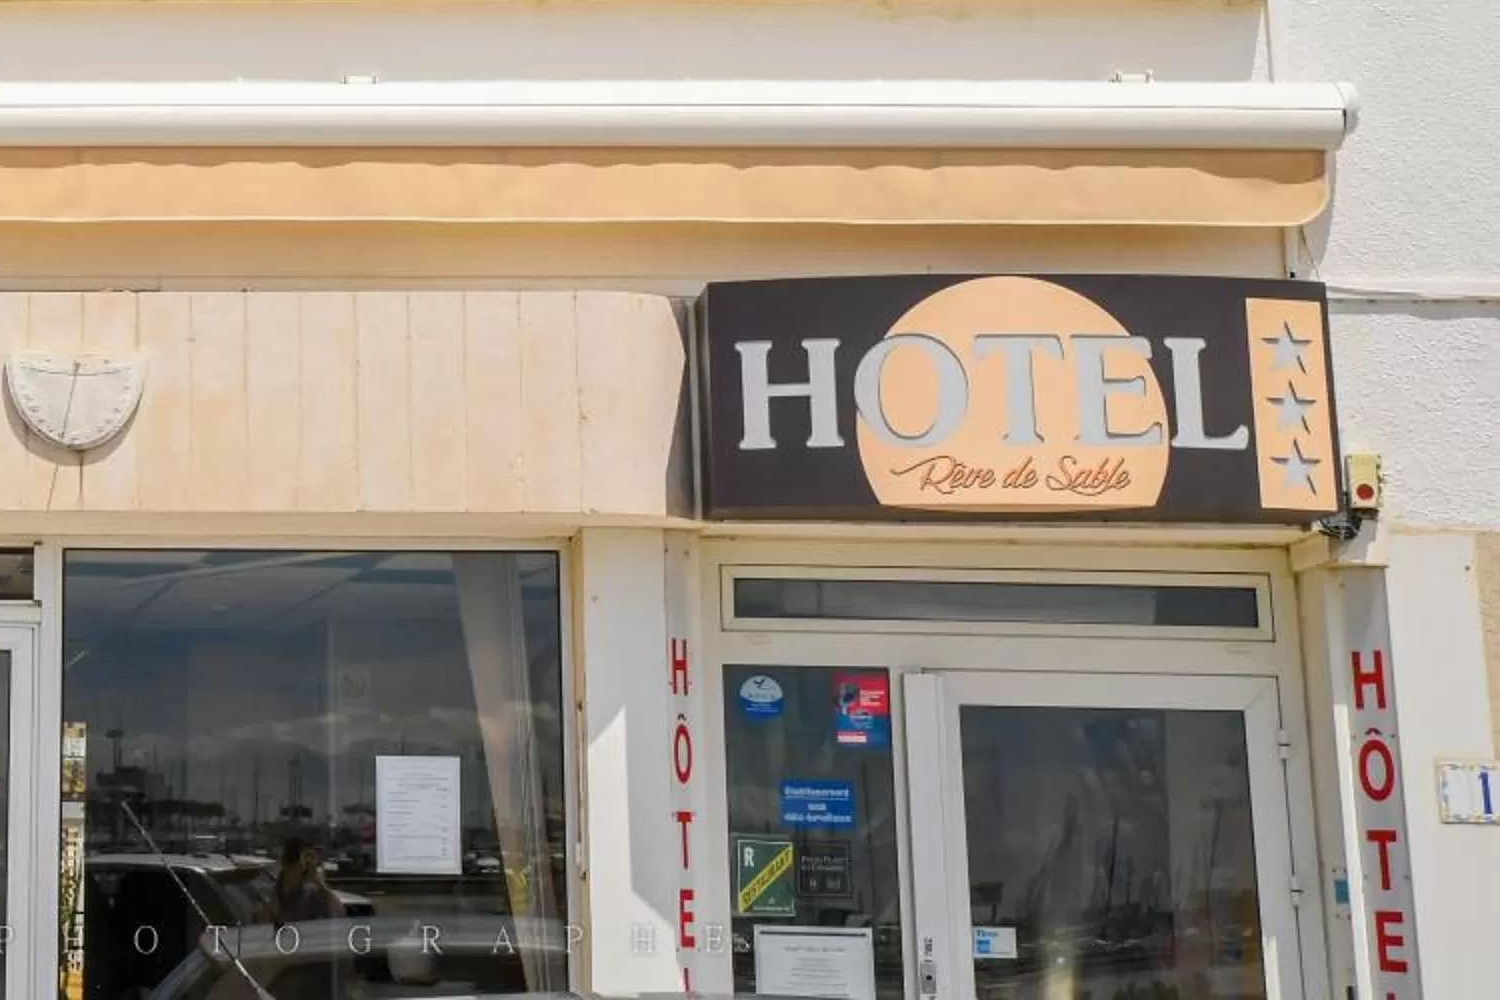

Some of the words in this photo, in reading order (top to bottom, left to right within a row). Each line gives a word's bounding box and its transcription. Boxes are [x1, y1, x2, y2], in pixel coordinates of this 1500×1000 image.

[734, 333, 1251, 451] HOTEL
[889, 454, 997, 495] Rêve
[1001, 455, 1039, 490] de
[1044, 454, 1132, 497] Sable
[1351, 650, 1409, 1000] HÔTE
